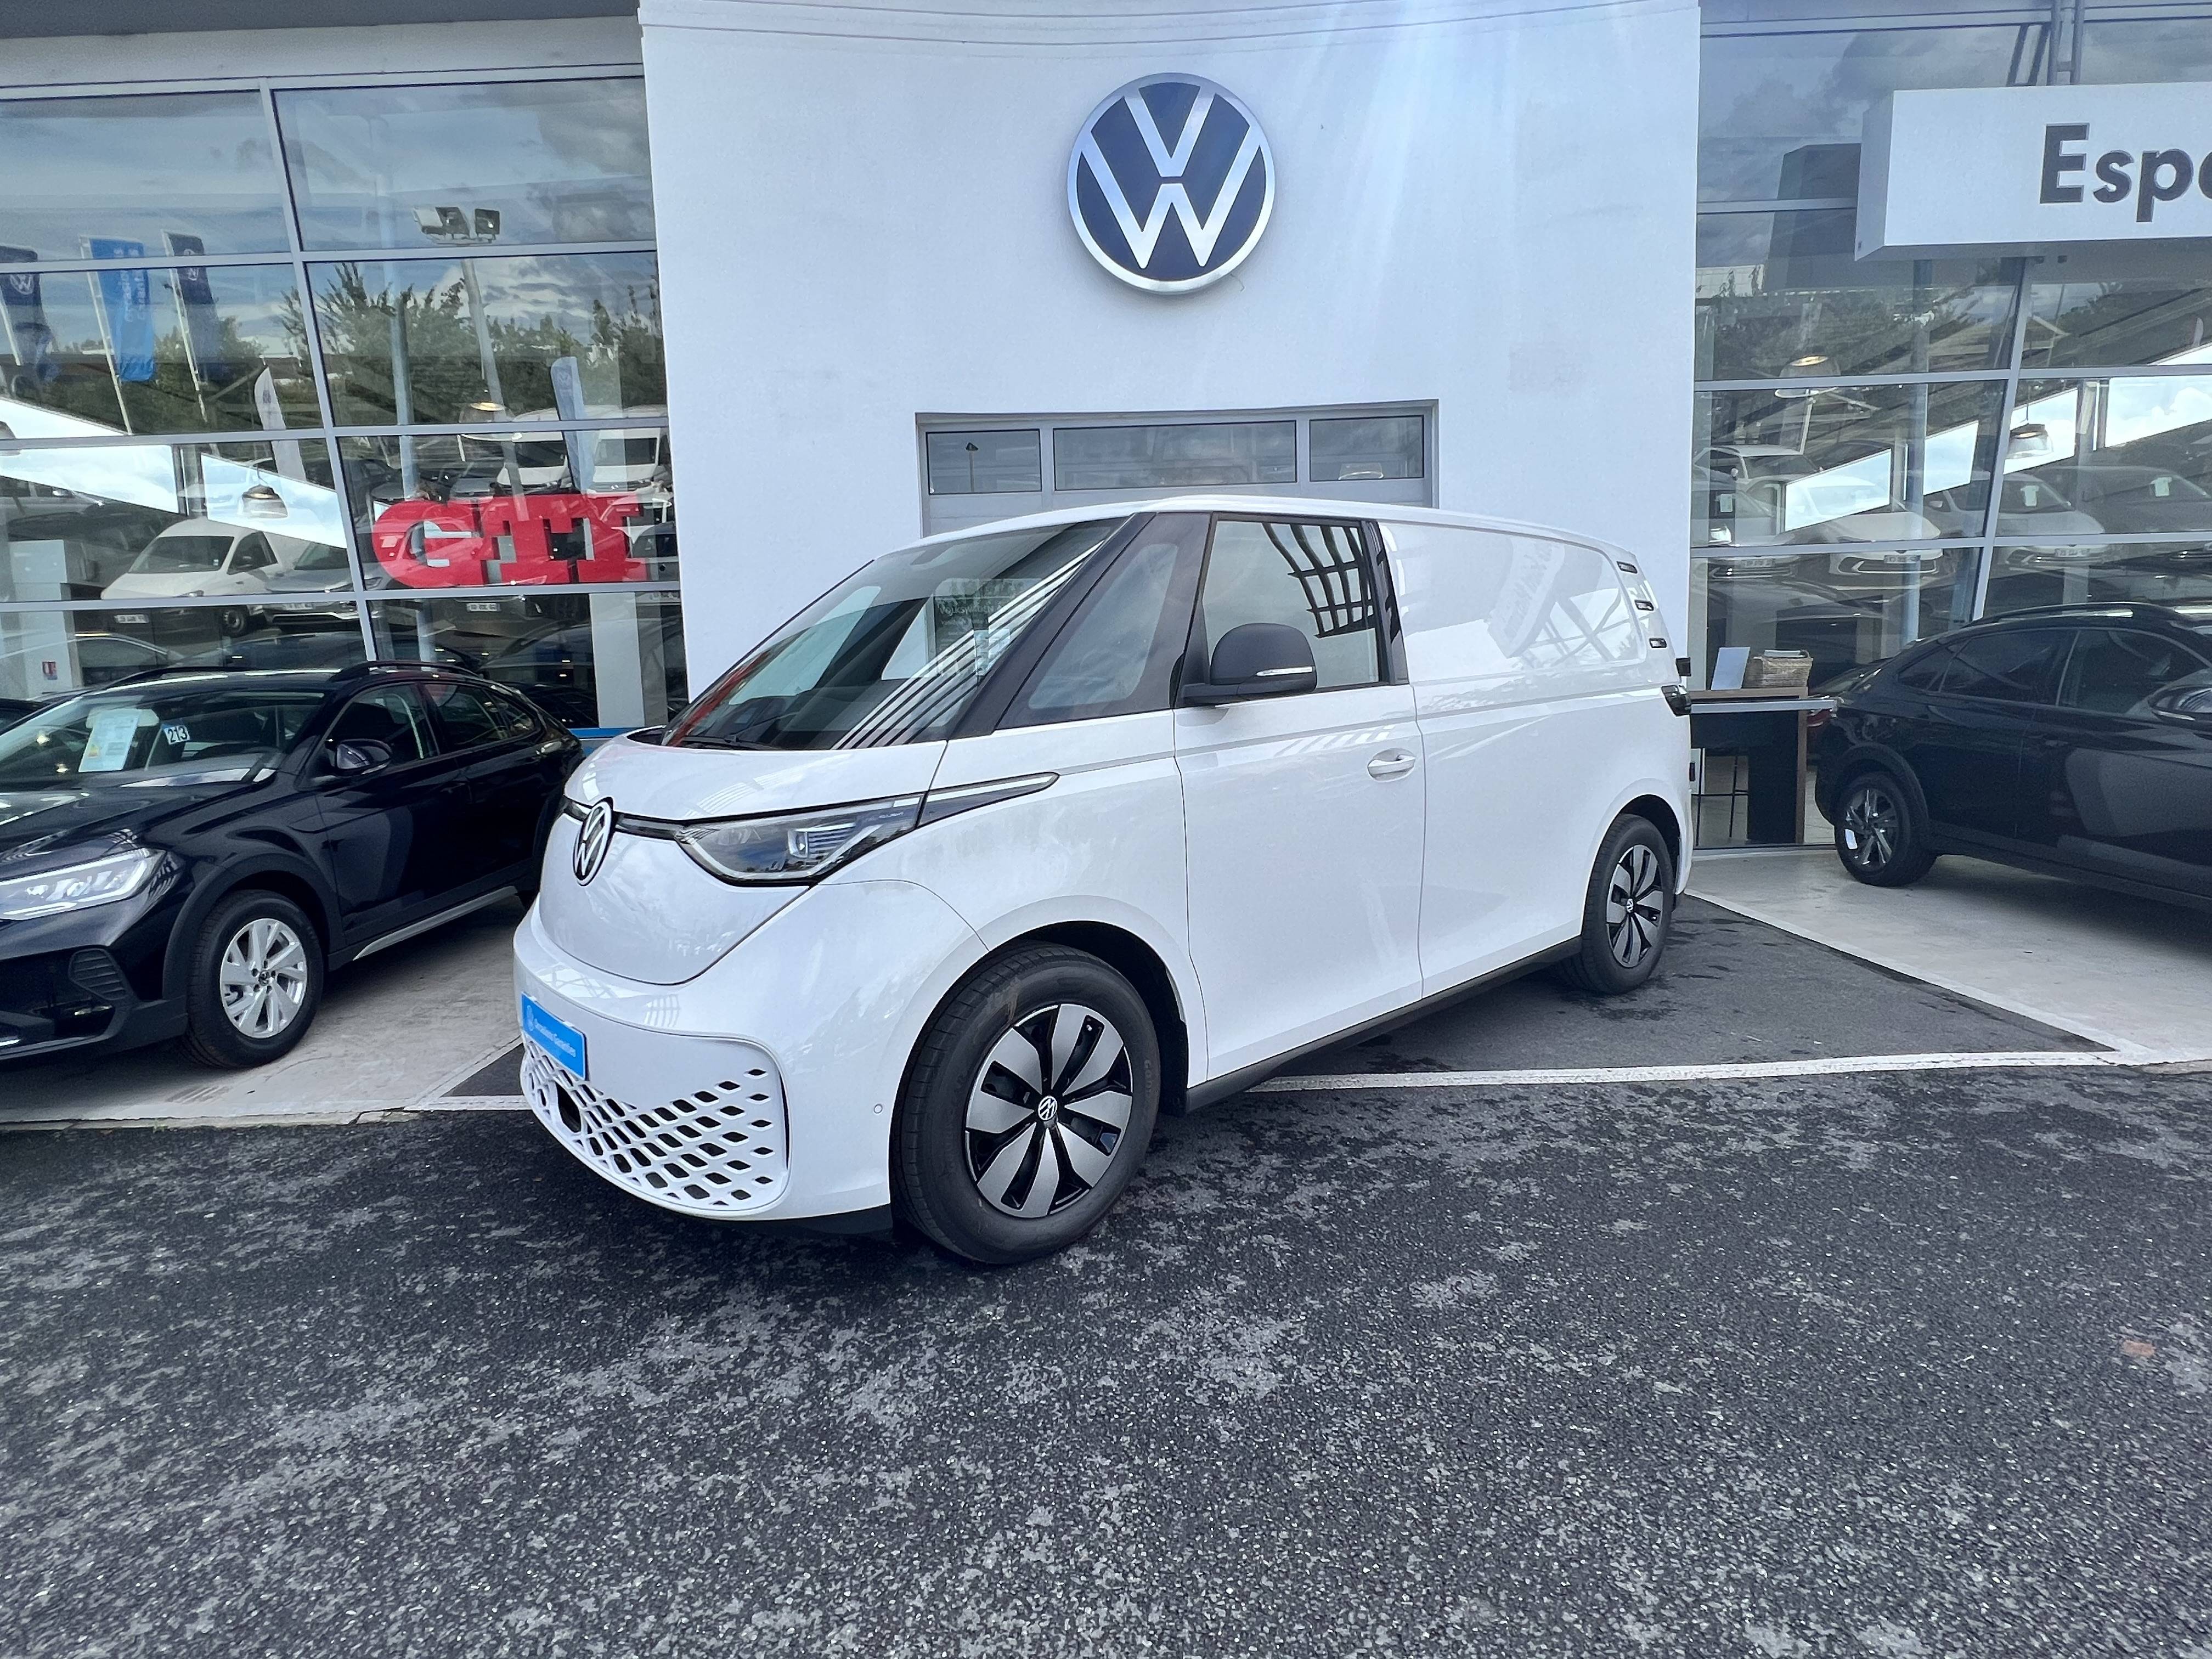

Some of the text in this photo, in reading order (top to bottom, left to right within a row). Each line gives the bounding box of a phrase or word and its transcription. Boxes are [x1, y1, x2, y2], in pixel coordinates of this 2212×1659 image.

[2040, 122, 2212, 223] Esp
[371, 493, 647, 588] GTI
[167, 725, 188, 743] 213
